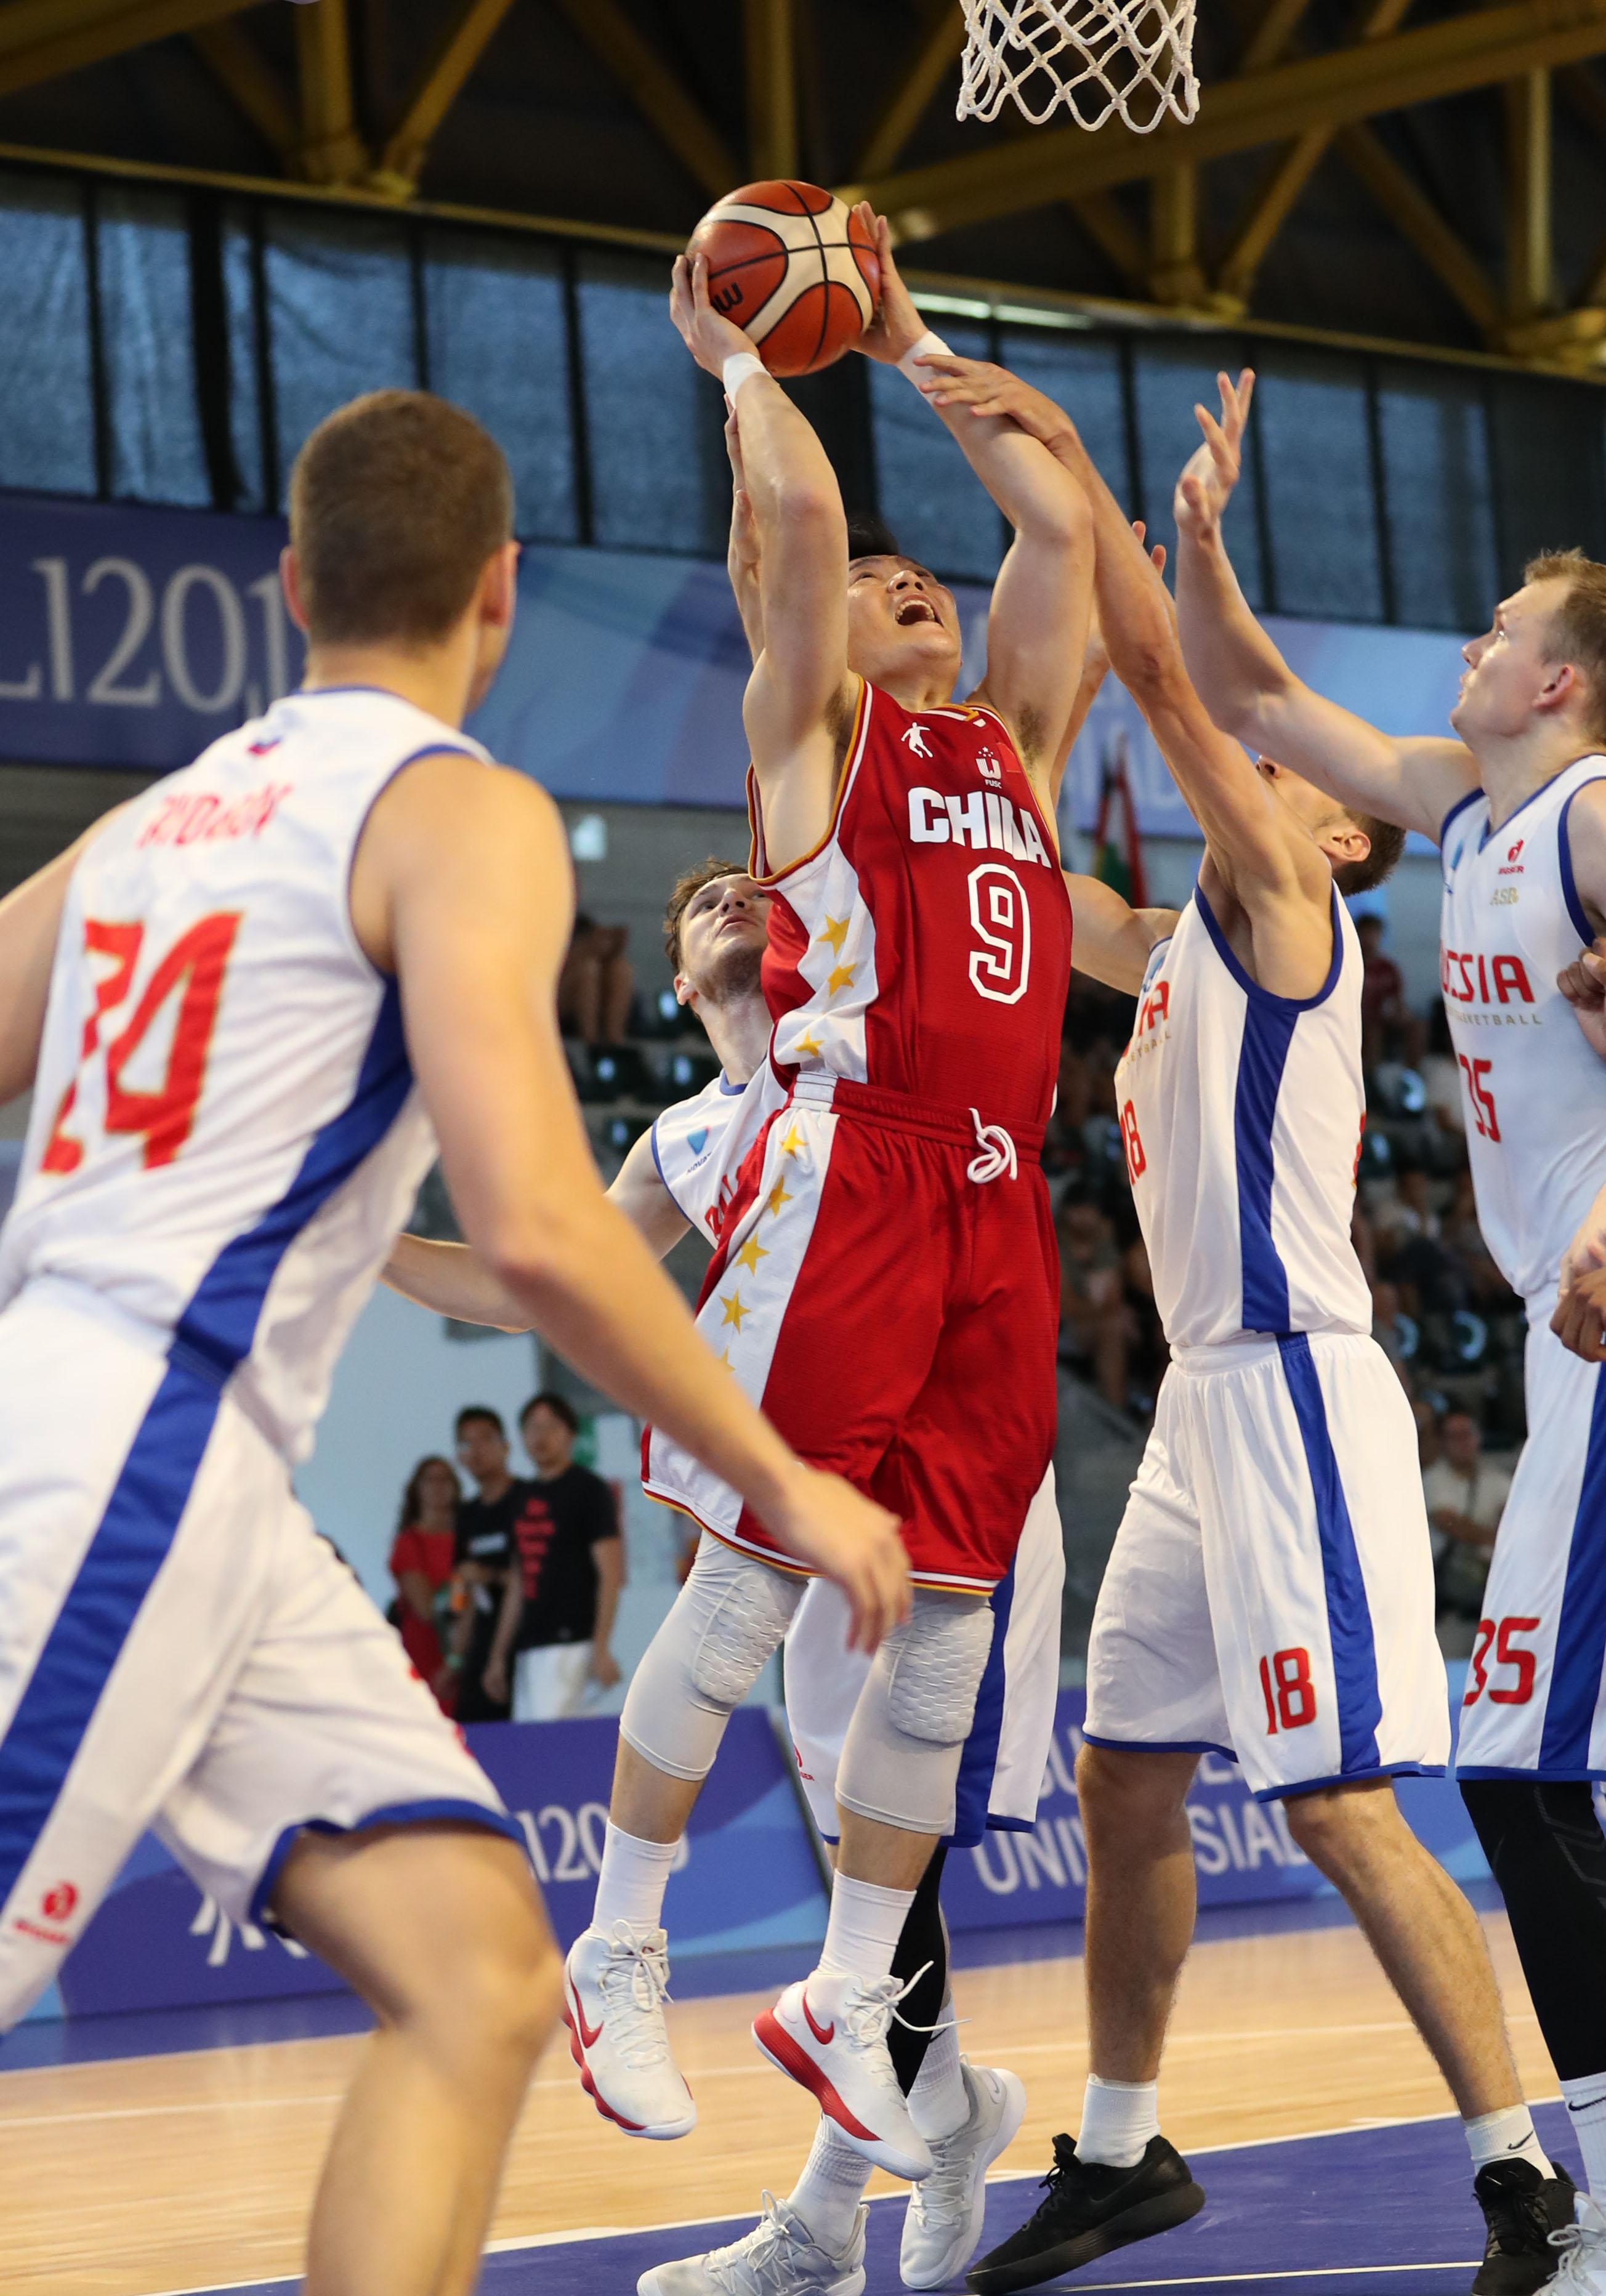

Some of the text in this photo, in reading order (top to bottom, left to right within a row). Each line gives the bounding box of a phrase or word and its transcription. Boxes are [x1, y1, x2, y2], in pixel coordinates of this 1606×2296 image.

[908, 787, 1052, 869] CHINA
[967, 863, 1031, 1004] 9
[1259, 1647, 1317, 1736] 18
[1463, 1617, 1541, 1706] 35
